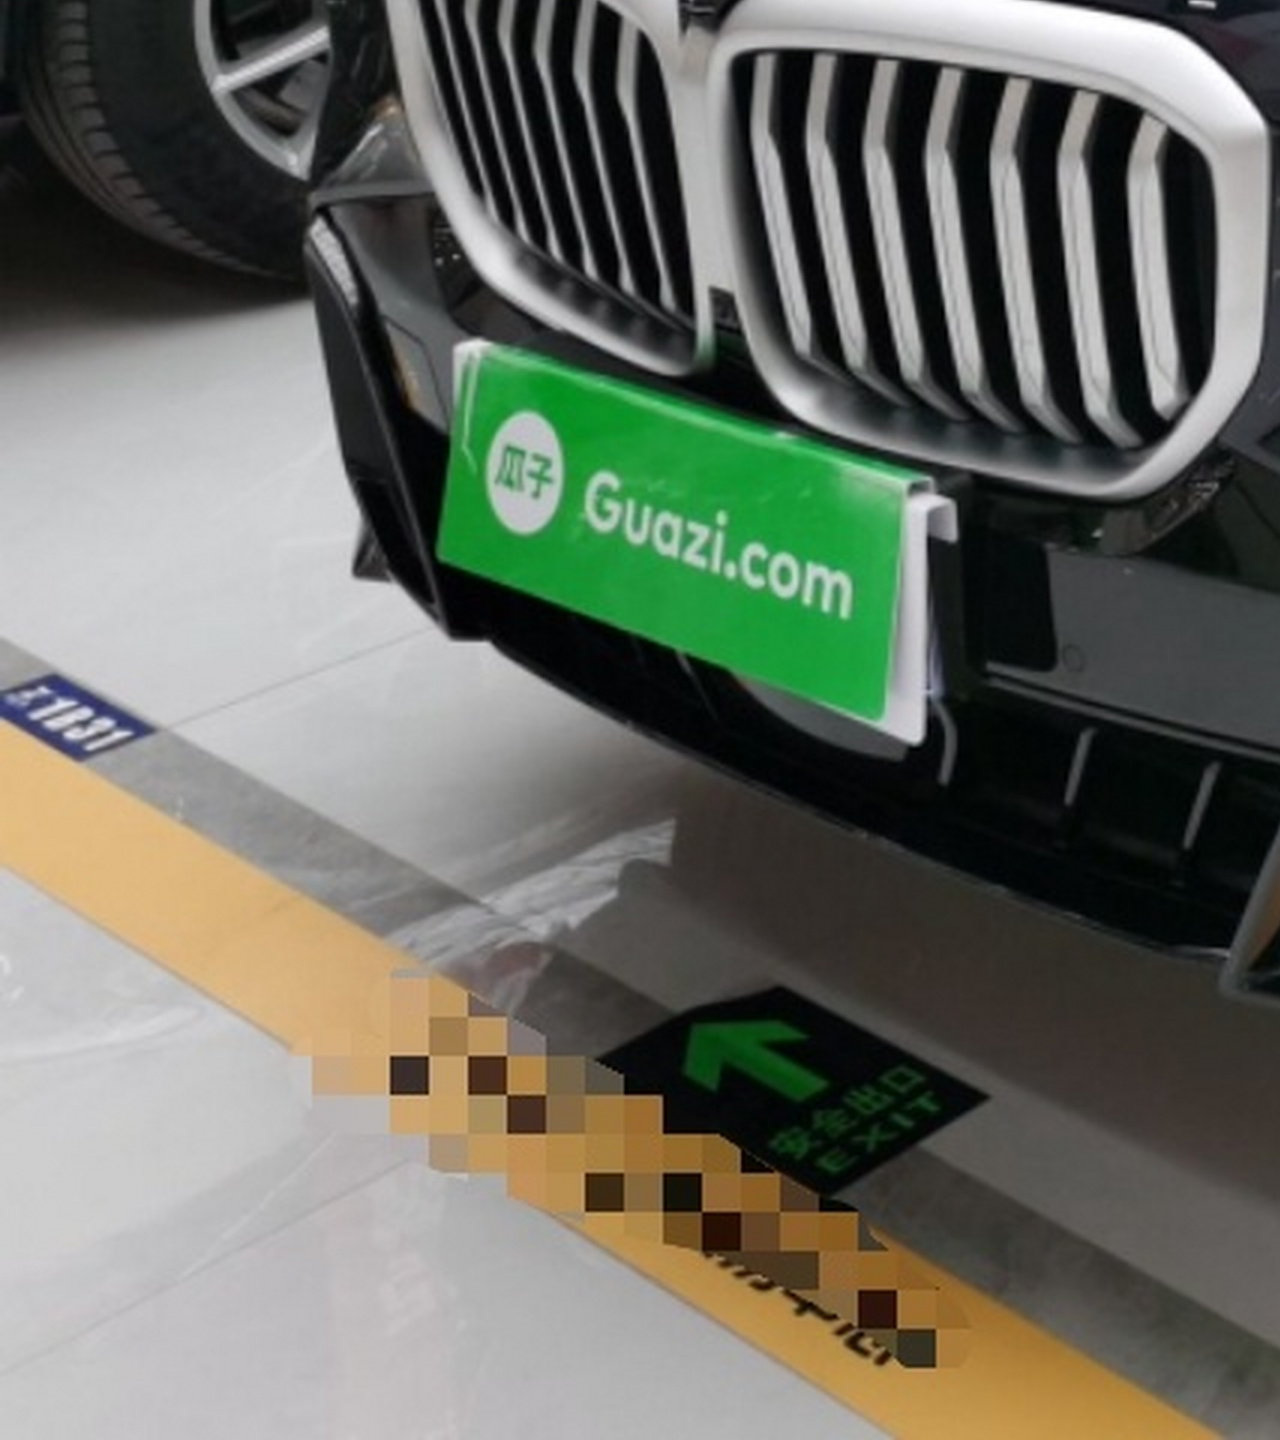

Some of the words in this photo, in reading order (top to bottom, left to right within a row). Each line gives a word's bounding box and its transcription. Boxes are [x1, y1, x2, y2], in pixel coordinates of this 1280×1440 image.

[495, 445, 555, 500] 瓜子
[584, 469, 855, 621] Guazi.com
[768, 1065, 928, 1161] 安全出口
[814, 1090, 941, 1175] EXIT
